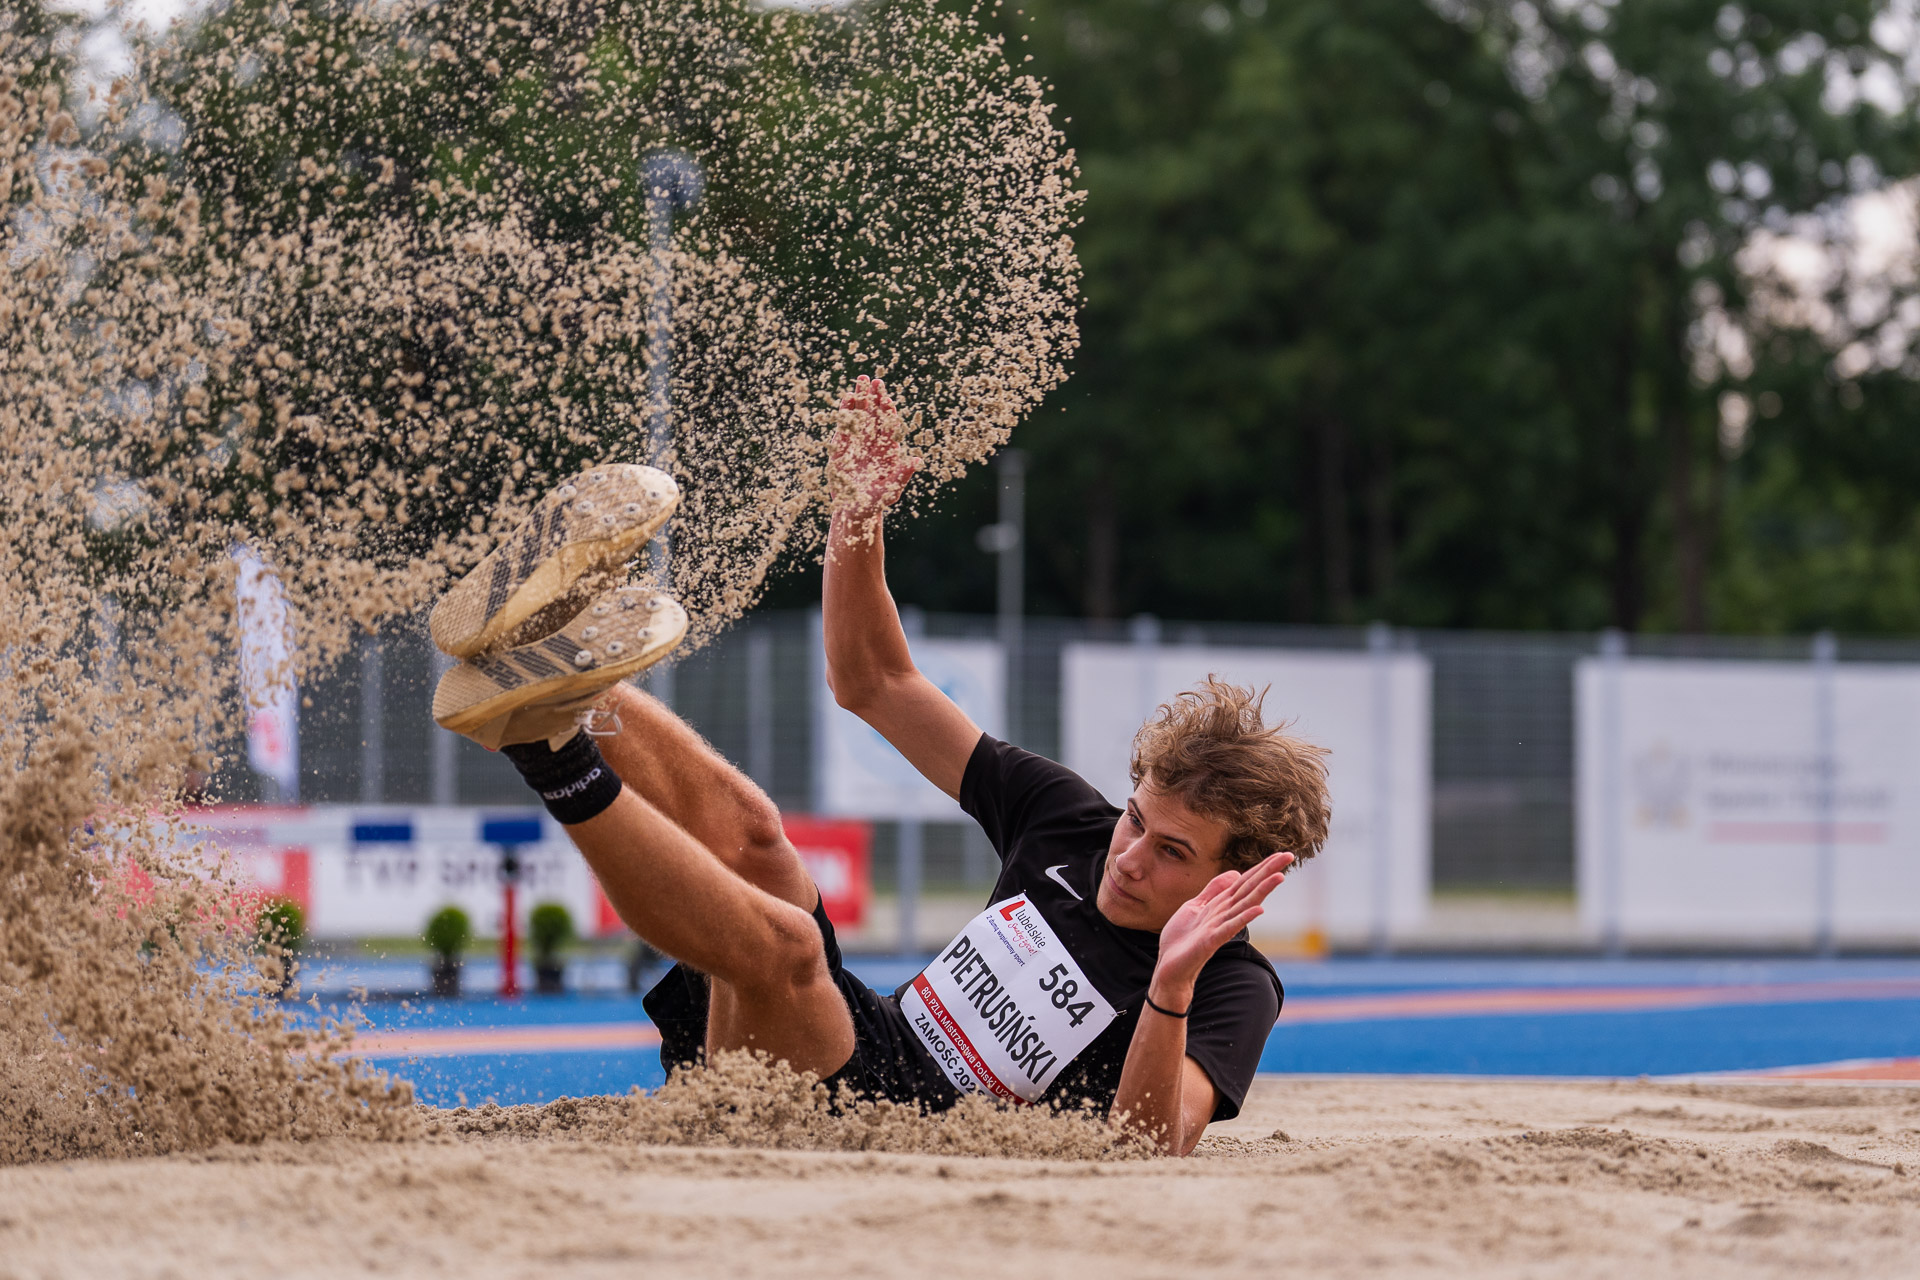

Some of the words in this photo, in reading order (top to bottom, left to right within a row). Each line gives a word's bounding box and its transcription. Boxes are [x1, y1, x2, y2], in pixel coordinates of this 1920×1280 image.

[543, 767, 601, 800] adidas
[1013, 952, 1025, 967] sport
[942, 935, 1058, 1085] PIETRUSIŃSKI
[1039, 963, 1096, 1028] 584
[915, 1012, 960, 1069] ZAMOŚĆ
[928, 998, 944, 1019] PZLA
[940, 1015, 976, 1064] Mistrzostwa
[973, 1061, 997, 1088] Polski
